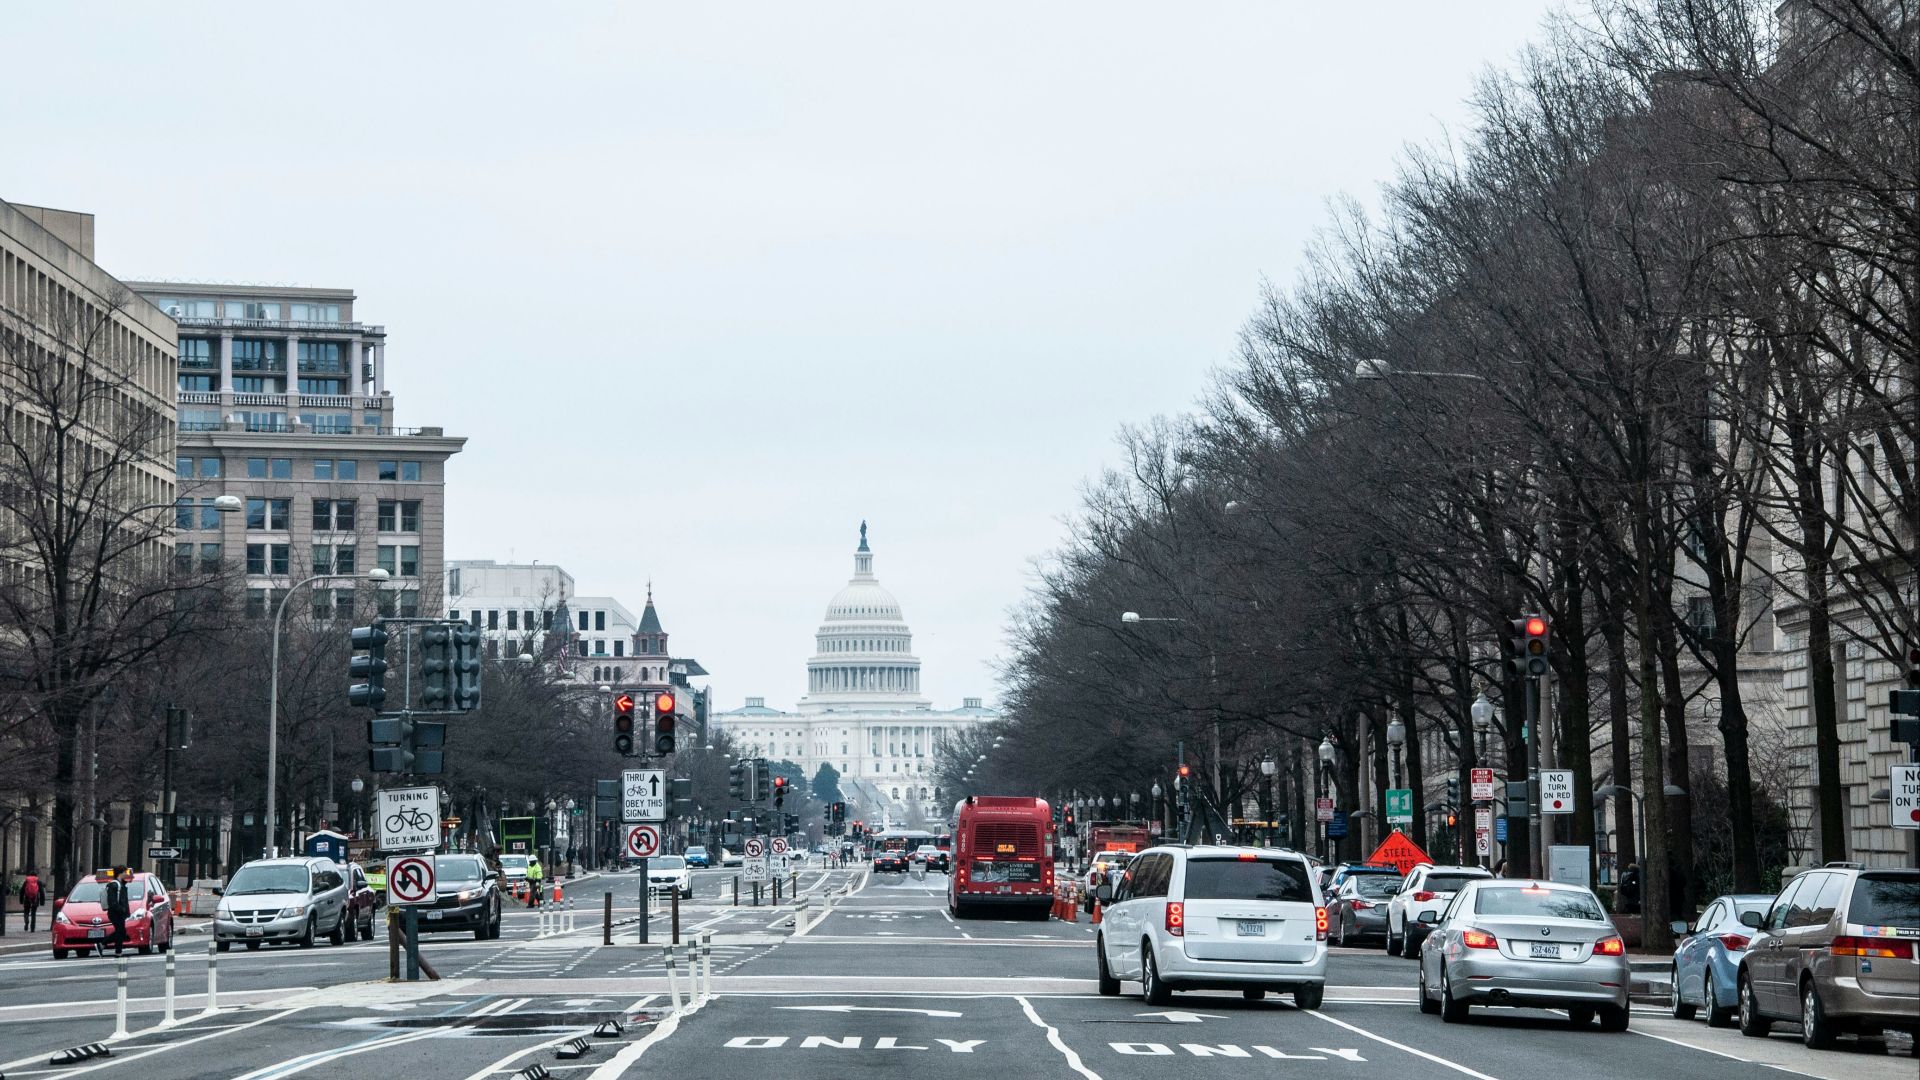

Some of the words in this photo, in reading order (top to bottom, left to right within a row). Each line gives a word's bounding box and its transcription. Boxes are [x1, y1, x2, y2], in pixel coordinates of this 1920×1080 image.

[626, 773, 645, 782] THRU
[1549, 774, 1564, 782] NO
[1547, 783, 1567, 791] TURN
[388, 792, 429, 802] TURNING
[625, 799, 645, 808] OBEY
[647, 799, 663, 808] THIS
[1895, 797, 1911, 807] ON
[625, 809, 651, 818] SIGNAL
[385, 836, 400, 846] USE
[402, 834, 435, 845] X-WALKS
[1383, 848, 1413, 857] STEEL
[723, 1036, 987, 1053] ONLY
[1108, 1042, 1369, 1062] ONLY
